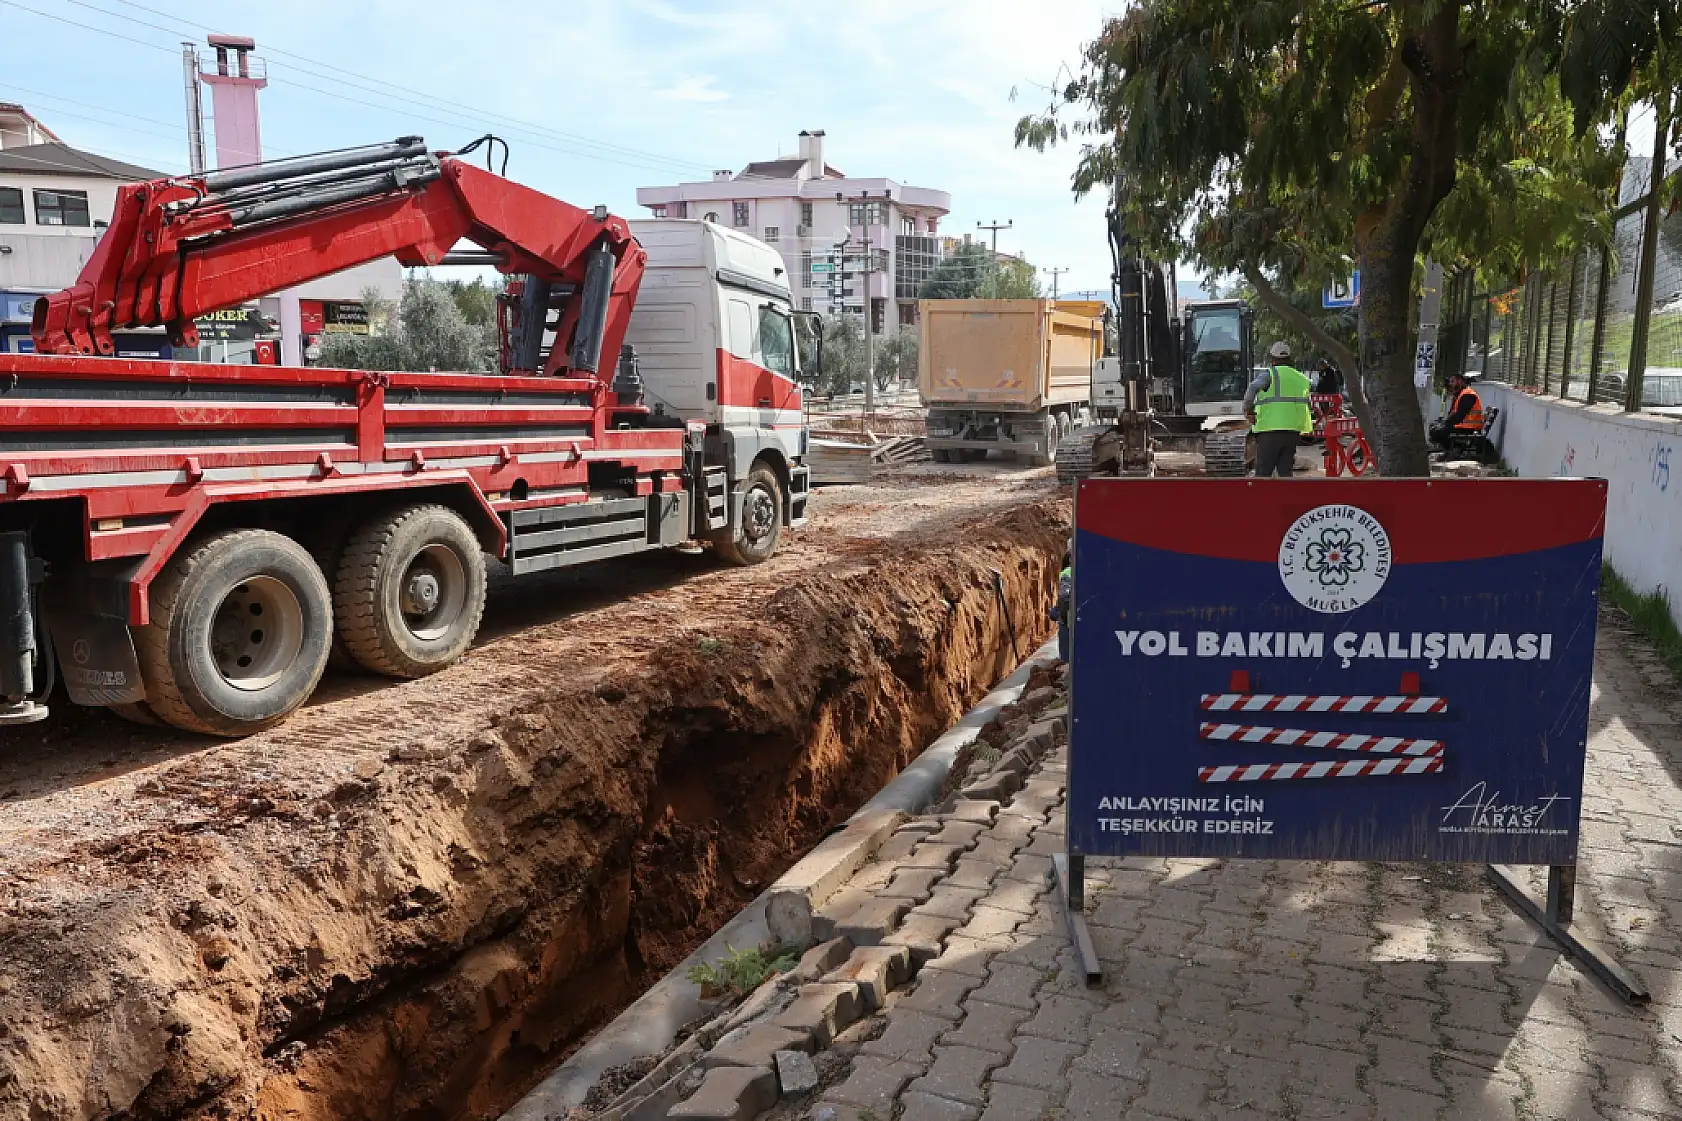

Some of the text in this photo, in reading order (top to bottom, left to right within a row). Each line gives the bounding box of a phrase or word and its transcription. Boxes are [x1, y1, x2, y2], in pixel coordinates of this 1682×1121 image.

[1283, 507, 1389, 579] T.C. BÜYÜKŞEHİR BELEDİYESİ
[1307, 597, 1359, 612] MUĞLA
[1114, 630, 1552, 669] YOL BAKIM ÇALIŞMASI
[1098, 794, 1264, 816] ANLAYIŞINIZ İÇİN
[1441, 780, 1571, 826] Ahmet
[1097, 815, 1274, 835] TEŞEKKÜR EDERİZ
[1477, 813, 1533, 828] ARAS
